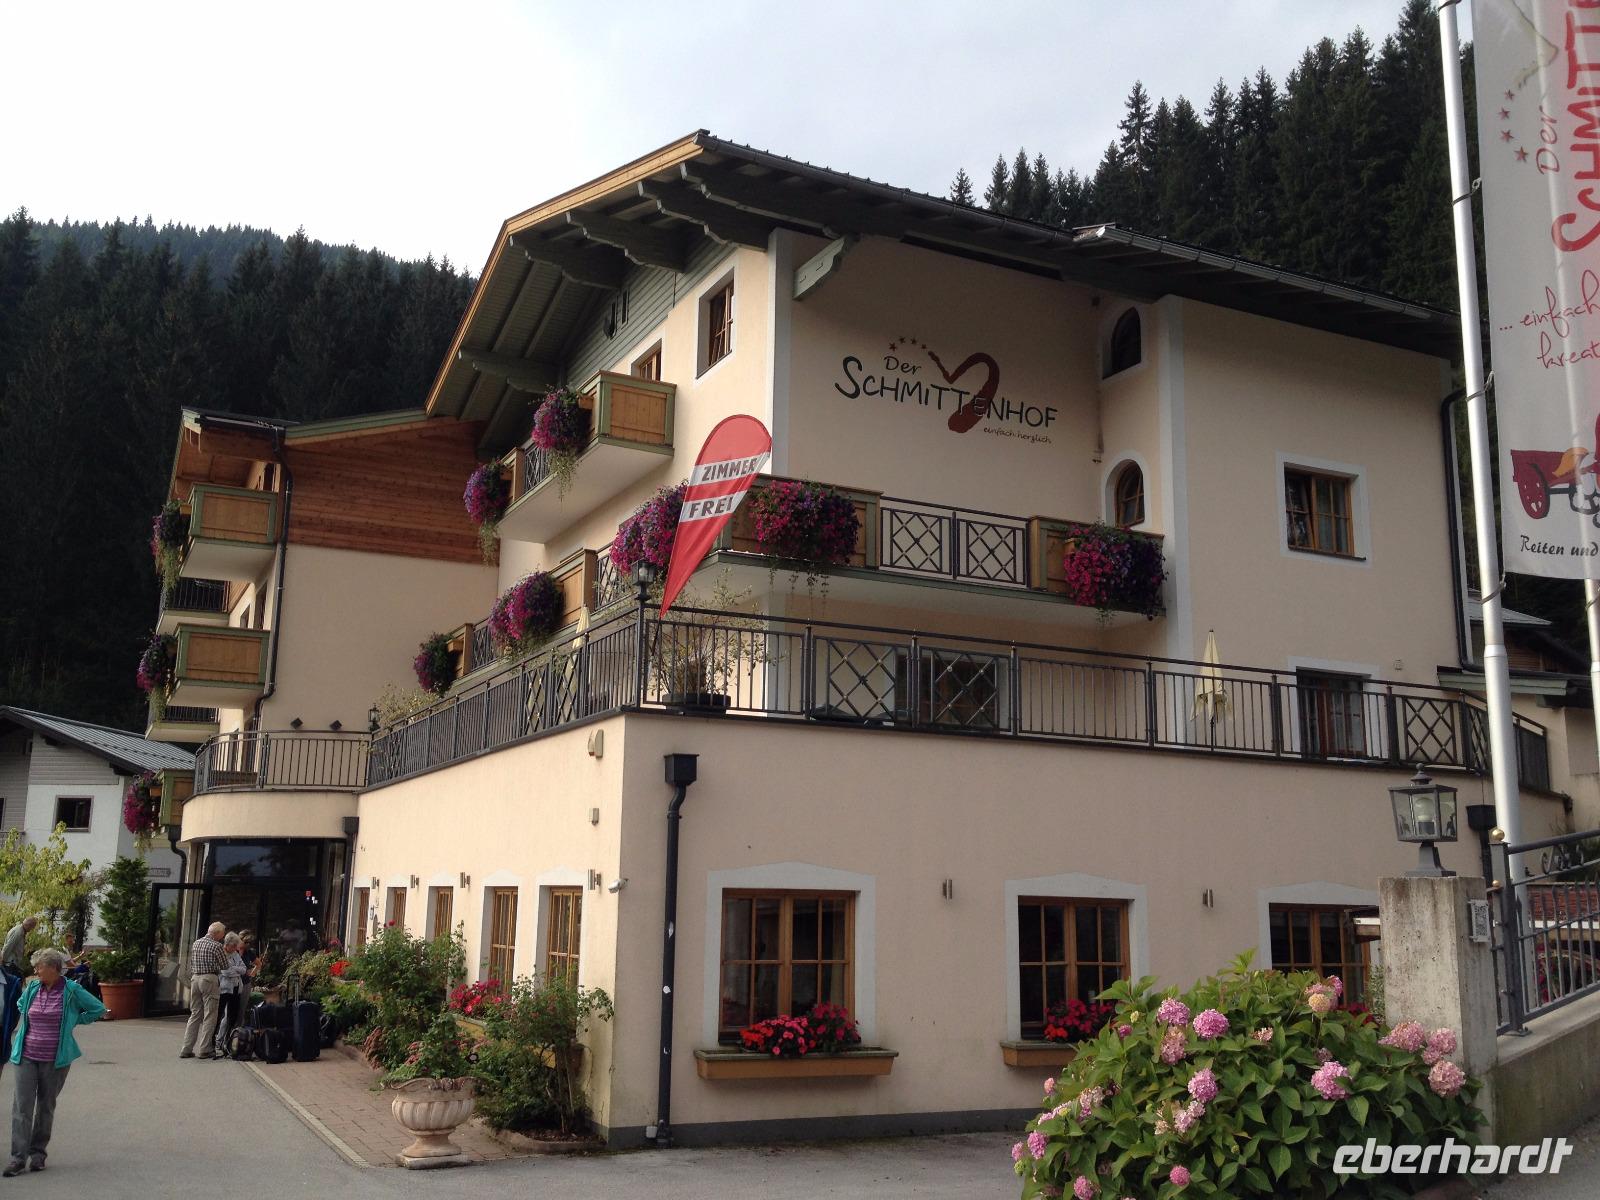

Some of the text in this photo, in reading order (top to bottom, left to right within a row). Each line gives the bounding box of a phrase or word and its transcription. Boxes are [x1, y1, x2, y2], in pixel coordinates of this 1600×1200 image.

[1536, 105, 1560, 175] Der
[883, 355, 922, 375] Der
[834, 355, 1058, 428] SCHMITTENHOF
[702, 458, 758, 482] ZIMMER
[689, 496, 734, 518] FREI
[1520, 534, 1599, 557] Reiten und
